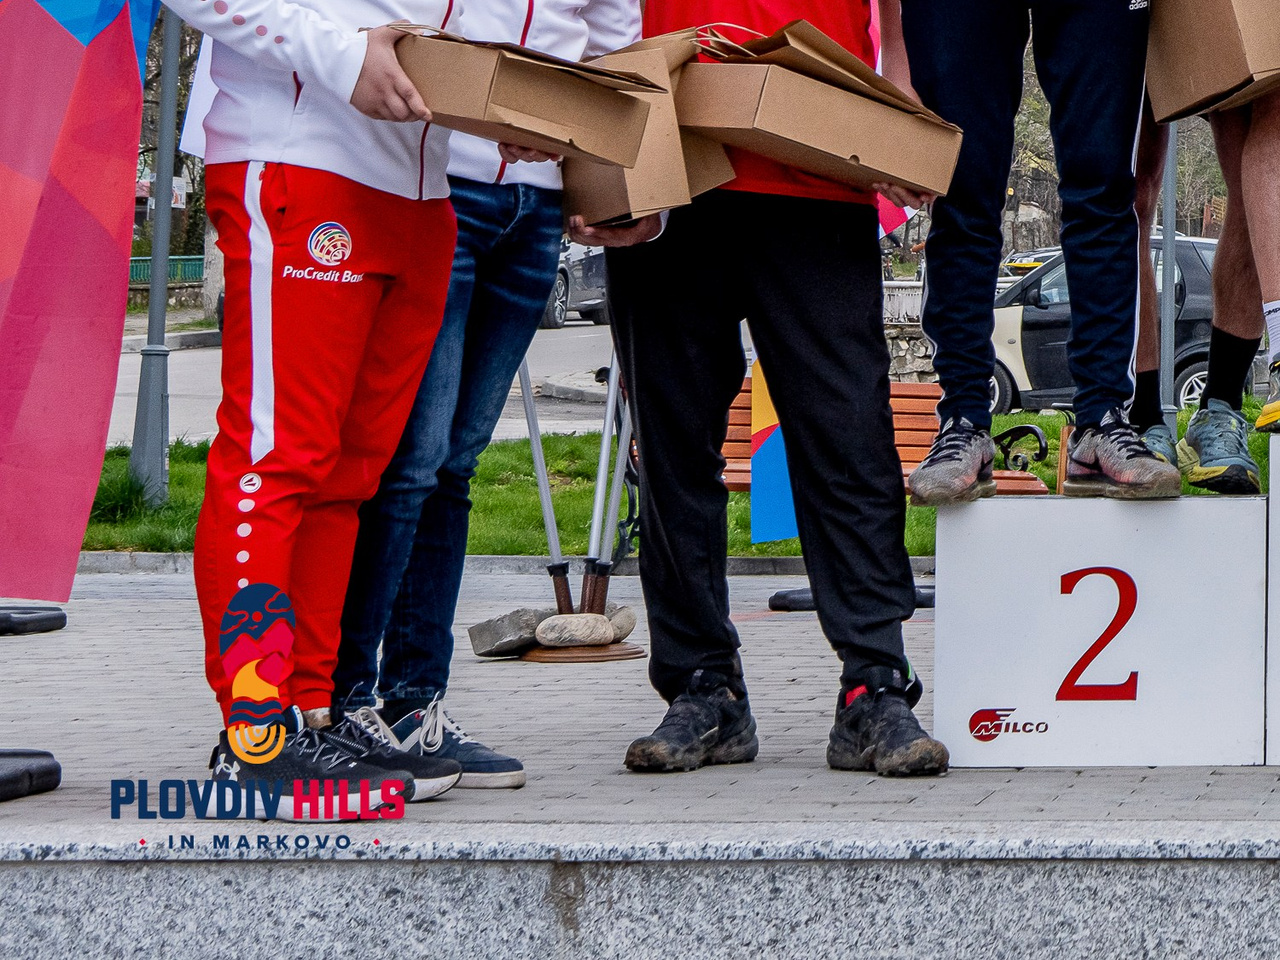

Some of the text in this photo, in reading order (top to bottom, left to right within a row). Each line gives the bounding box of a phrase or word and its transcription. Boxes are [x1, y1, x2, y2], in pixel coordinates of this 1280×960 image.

[283, 265, 340, 282] ProCredit
[1055, 566, 1138, 702] 2
[972, 722, 1048, 736] MILCO
